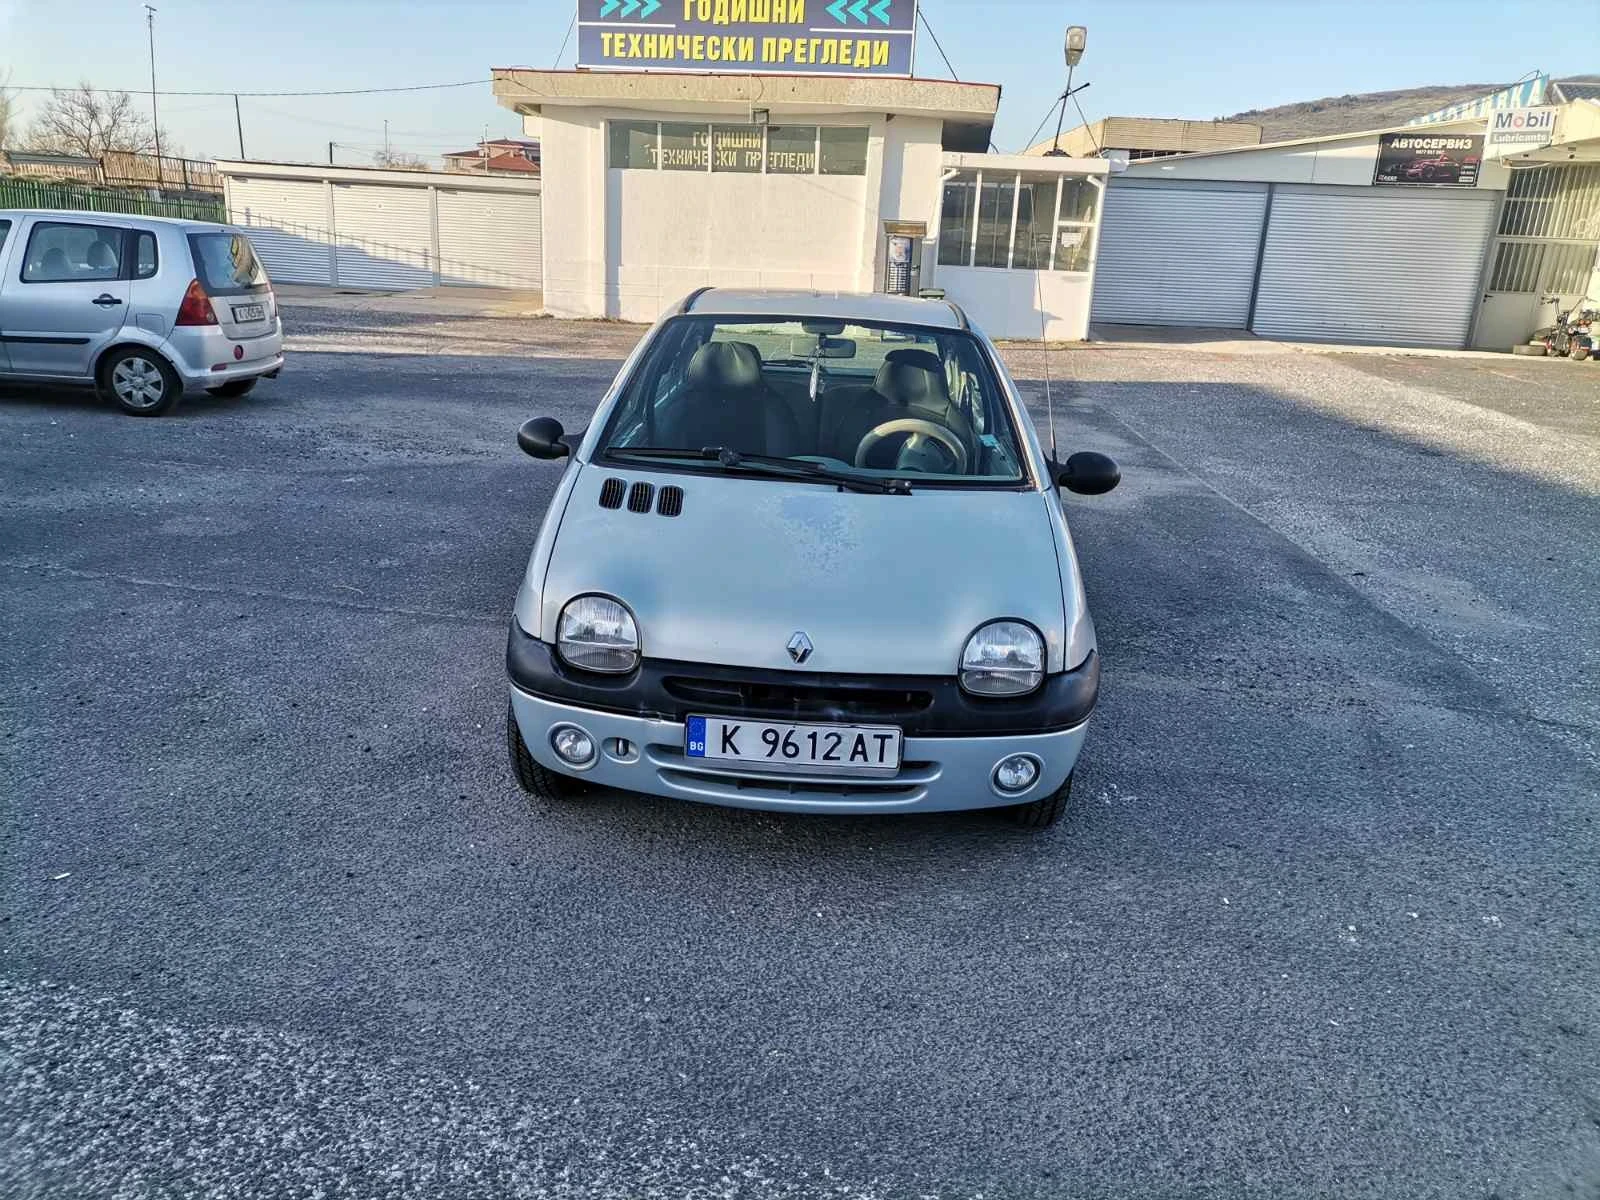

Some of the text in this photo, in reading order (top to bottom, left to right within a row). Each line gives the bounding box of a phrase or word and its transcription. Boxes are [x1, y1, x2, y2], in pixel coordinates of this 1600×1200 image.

[683, 0, 805, 25] ГОДИШНИ
[600, 32, 890, 68] ТЕХНИЧЕСКИ ПРЕГЛЕДИ
[1495, 111, 1551, 128] Mobil
[1391, 138, 1473, 149] АВТОСЕРВИЗ
[689, 741, 704, 752] BG
[721, 724, 741, 755] K
